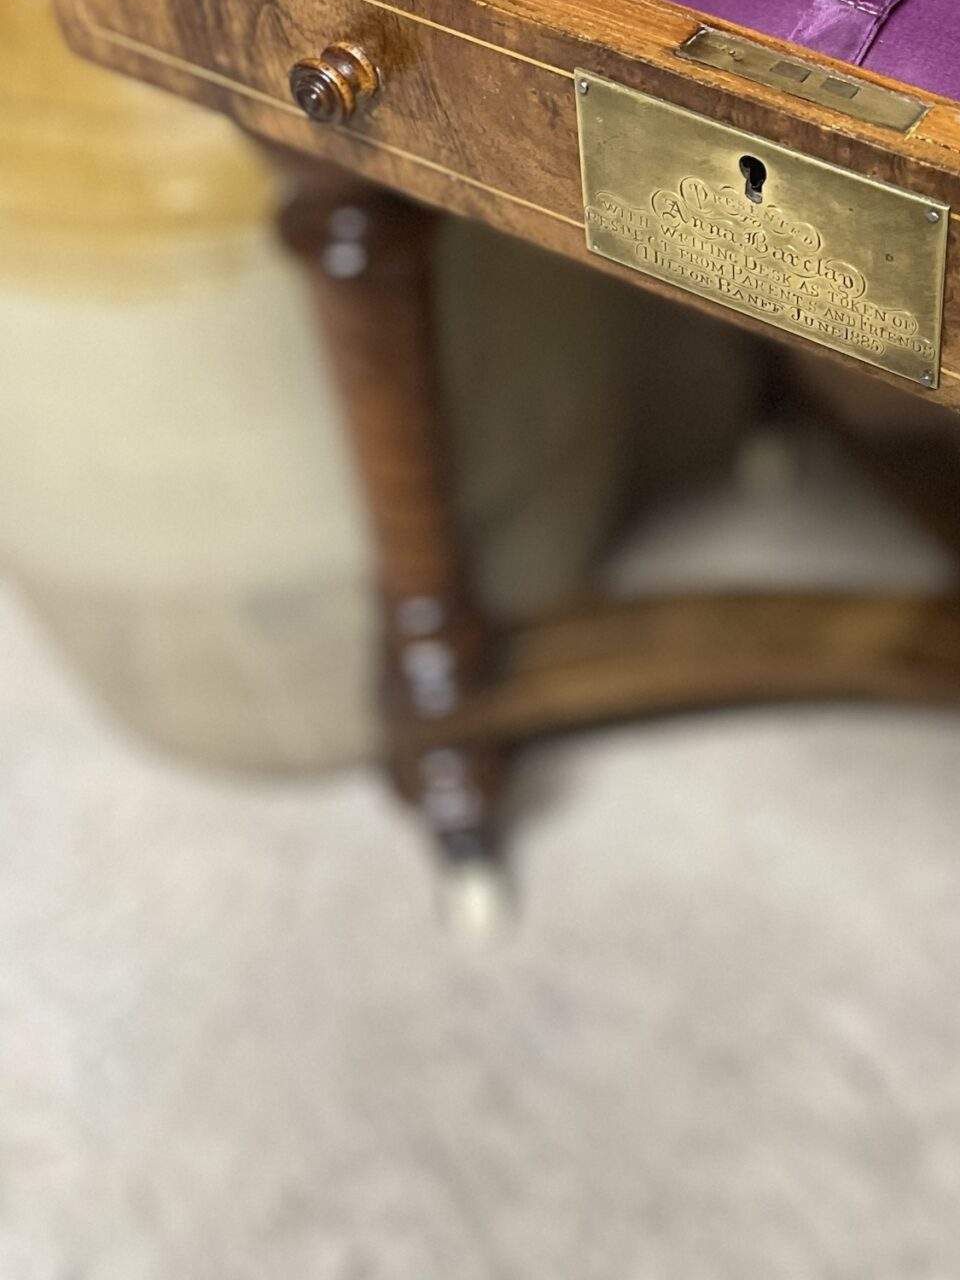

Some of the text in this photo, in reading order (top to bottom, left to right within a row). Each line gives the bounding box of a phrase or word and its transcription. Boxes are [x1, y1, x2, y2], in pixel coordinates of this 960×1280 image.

[586, 210, 667, 252] RESPECT
[679, 246, 724, 275] FROM
[730, 263, 818, 312] PARENTS
[823, 303, 856, 328] AND
[602, 199, 649, 229] WITH
[659, 222, 738, 265] WRITING
[744, 253, 791, 285] DESK
[799, 277, 819, 297] AS
[827, 288, 887, 323] TOKEN
[717, 276, 786, 316] BANFF
[789, 303, 840, 337] JUNE
